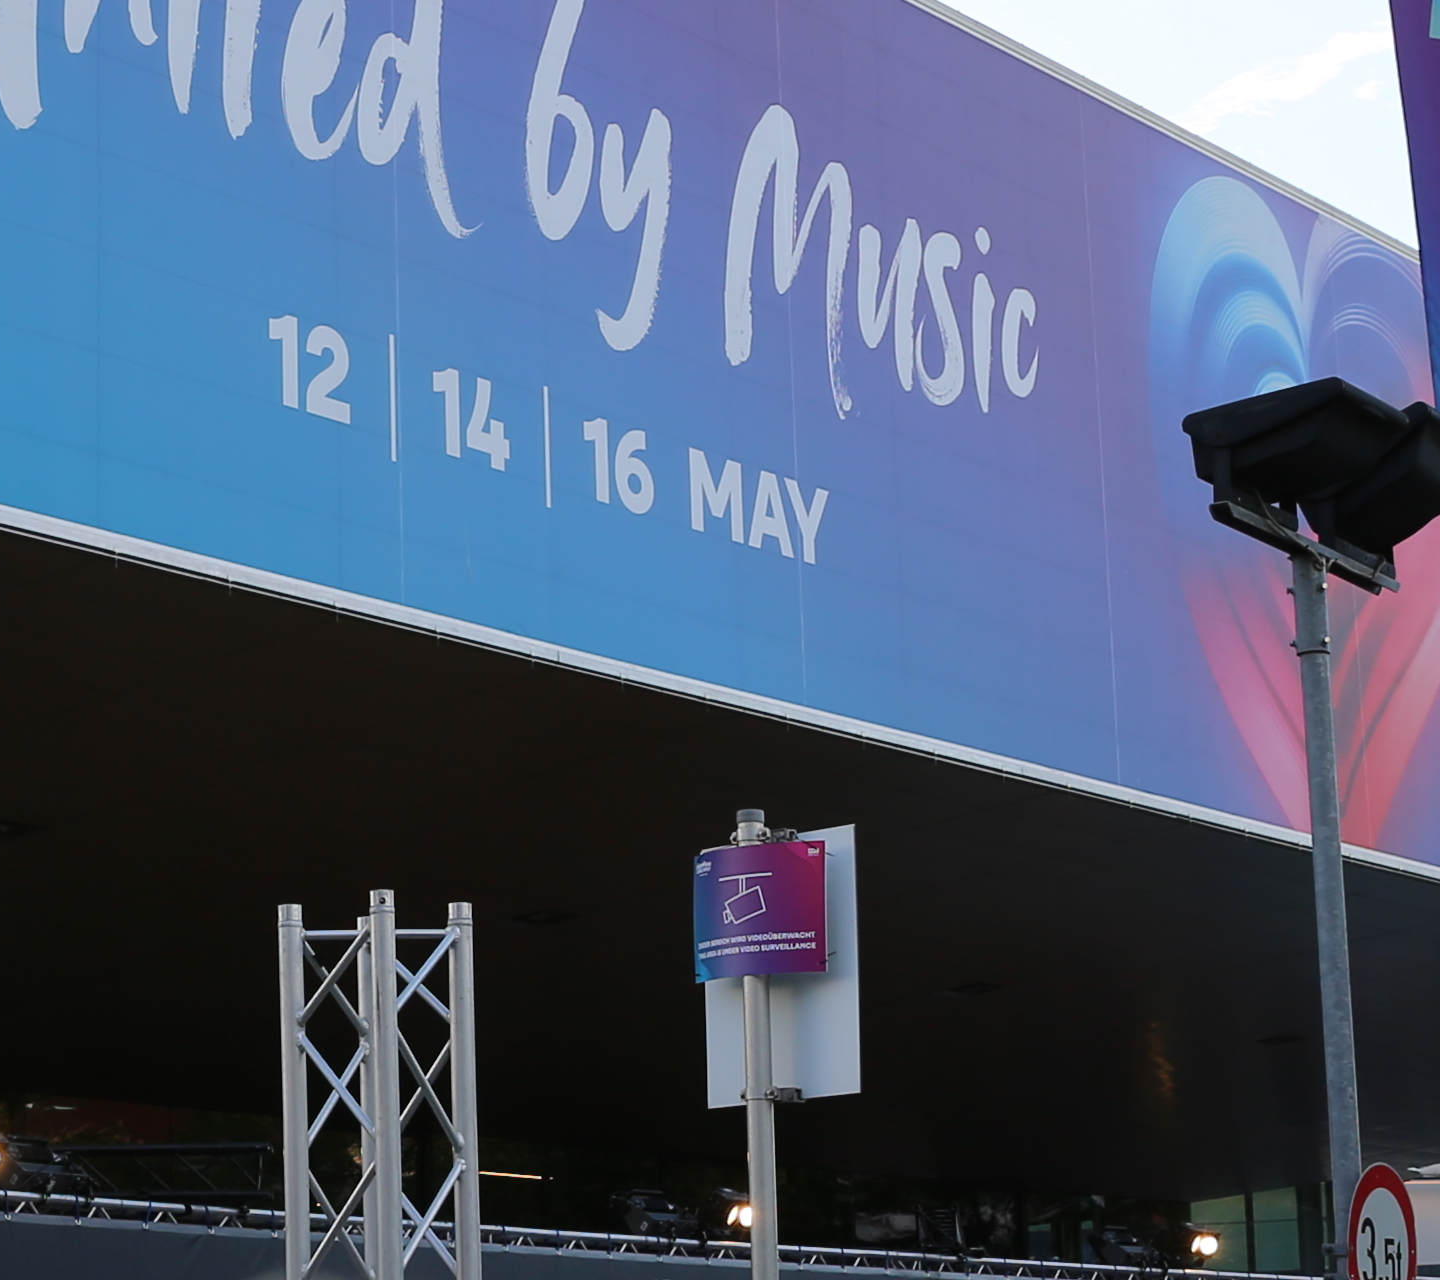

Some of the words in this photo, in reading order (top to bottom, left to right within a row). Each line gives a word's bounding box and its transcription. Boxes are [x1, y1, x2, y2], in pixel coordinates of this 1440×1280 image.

[723, 104, 1040, 422] Music
[268, 313, 352, 426] 12
[431, 367, 511, 472] 14
[583, 417, 655, 516] 16
[687, 446, 830, 567] MAY
[741, 944, 760, 954] VIDEO
[761, 941, 817, 953] SURVEILLANCE
[747, 930, 816, 943] VIDEOÜBERWACHT
